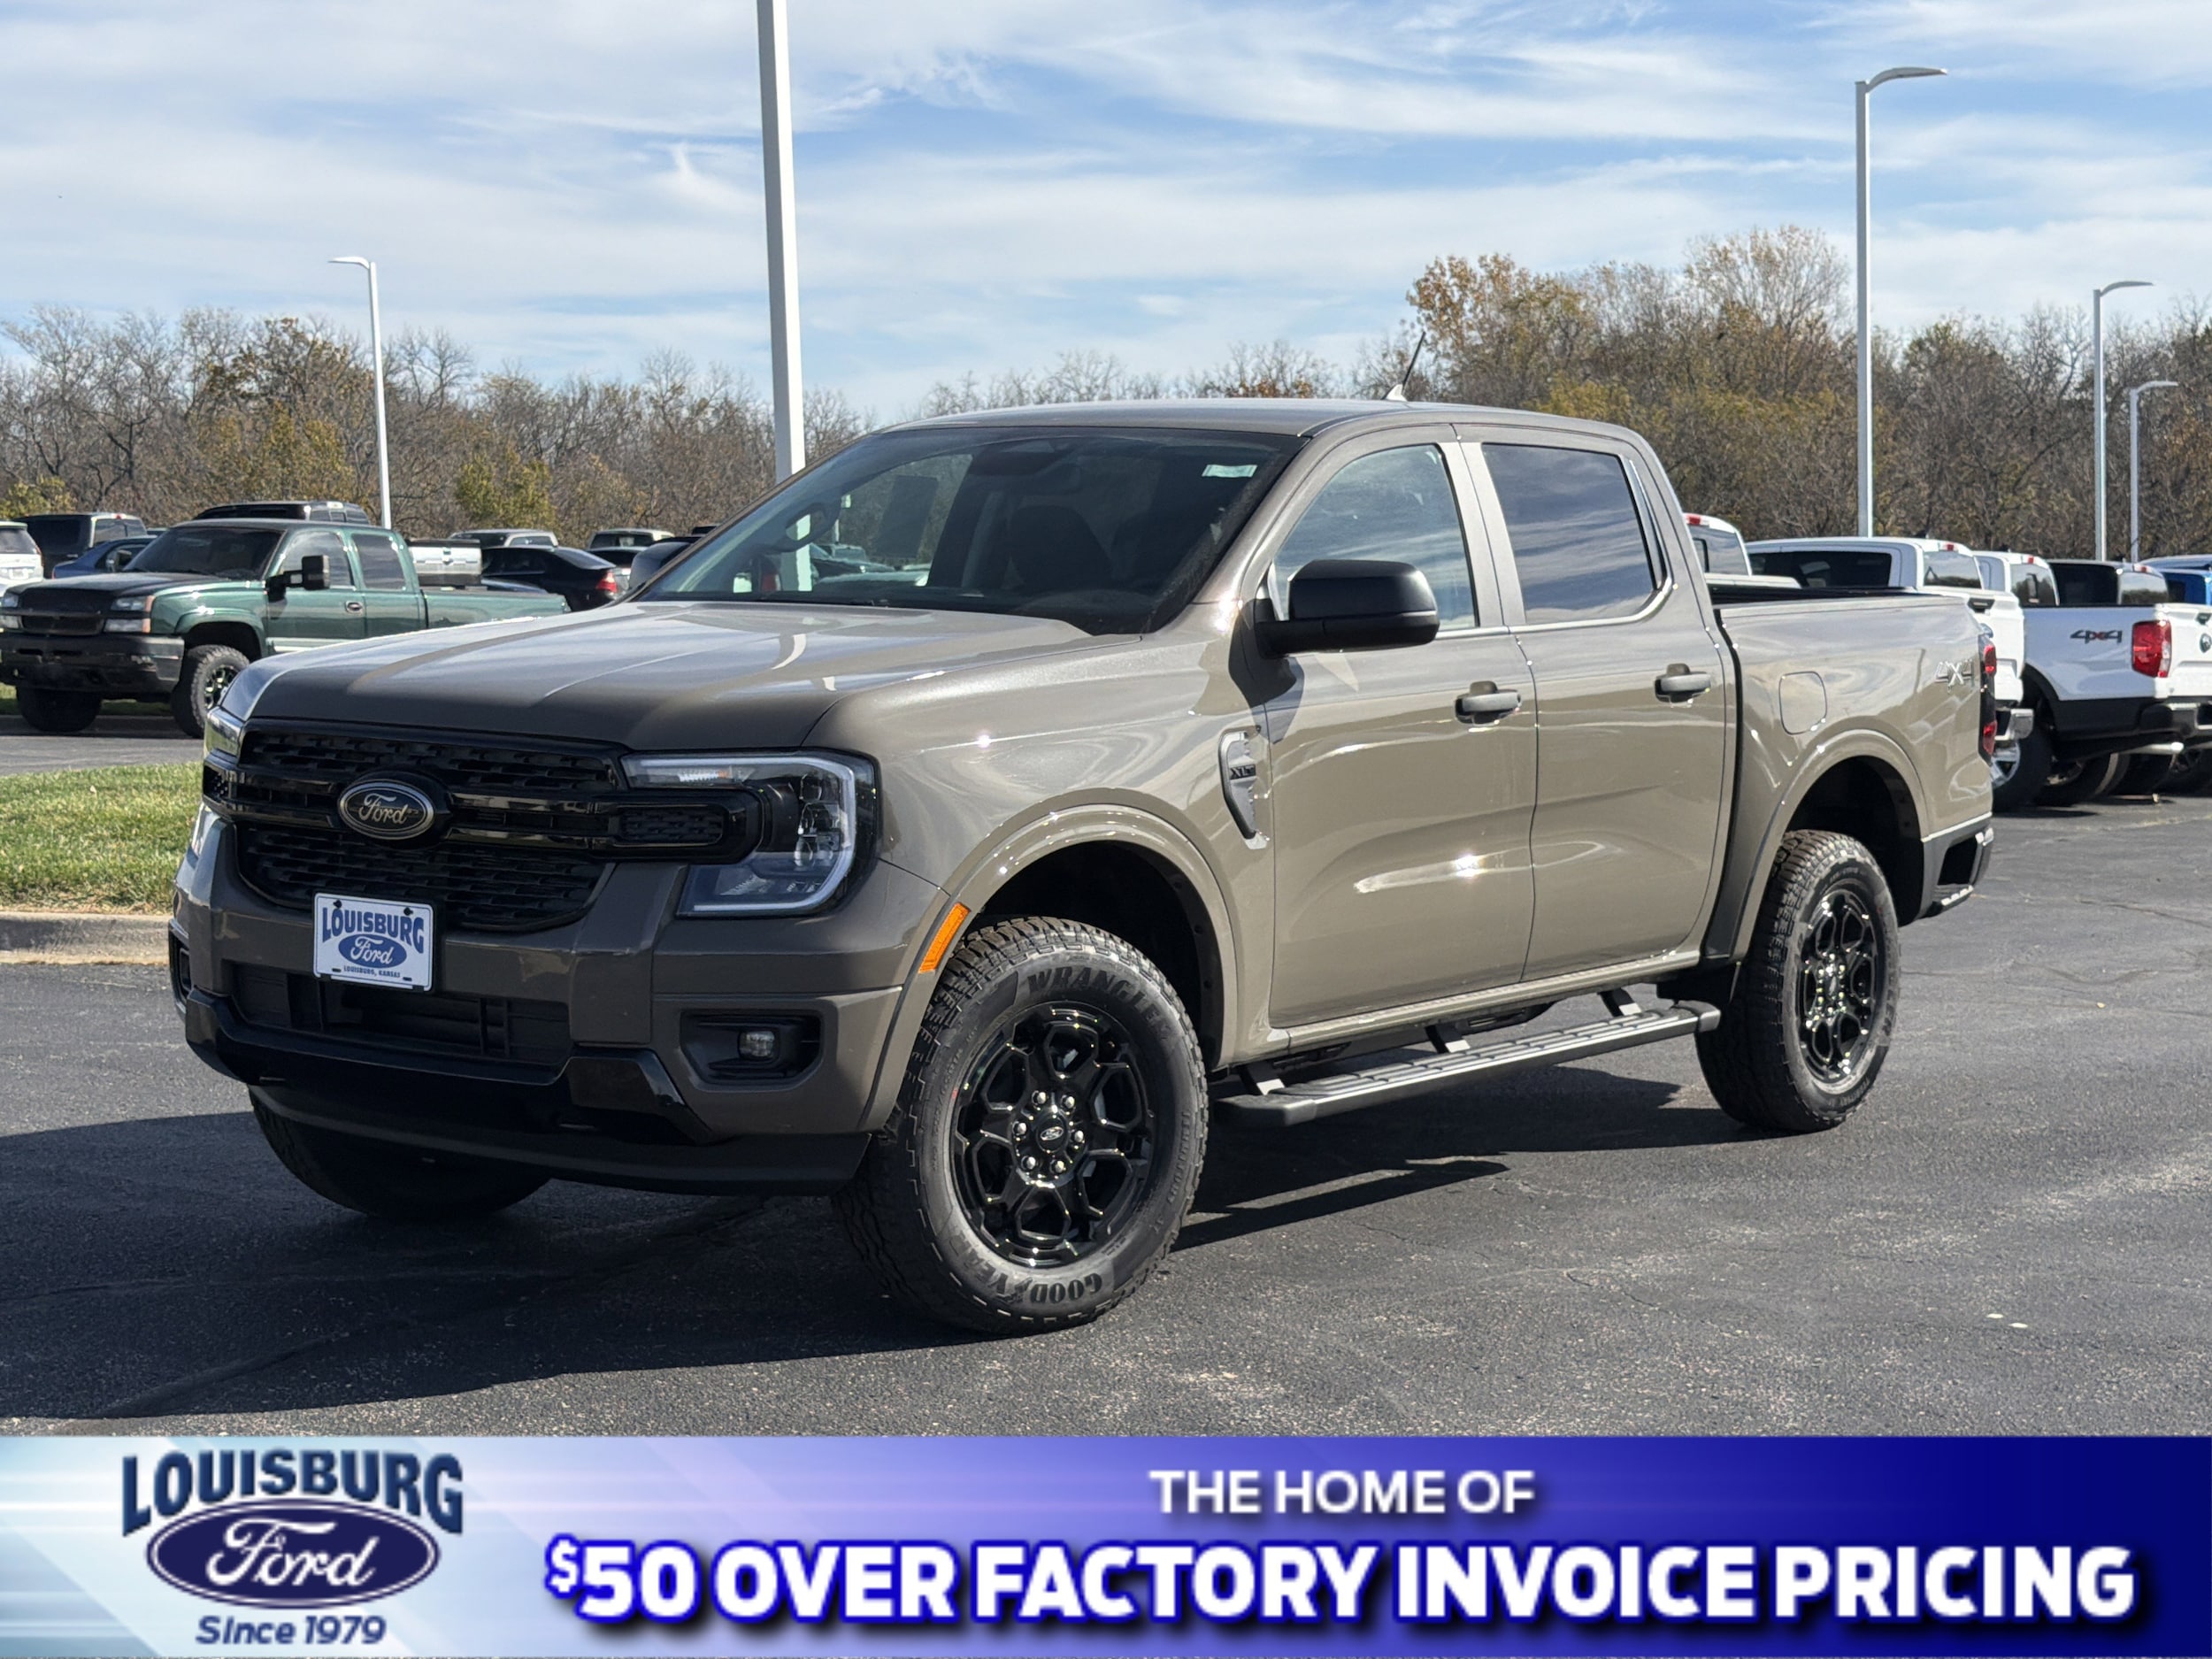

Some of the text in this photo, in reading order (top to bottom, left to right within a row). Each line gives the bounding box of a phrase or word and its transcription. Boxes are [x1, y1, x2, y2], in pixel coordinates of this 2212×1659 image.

[1230, 764, 1256, 779] XLT
[358, 793, 408, 824] Ford
[322, 907, 424, 954] LOUISBURG
[349, 936, 395, 964] Ford
